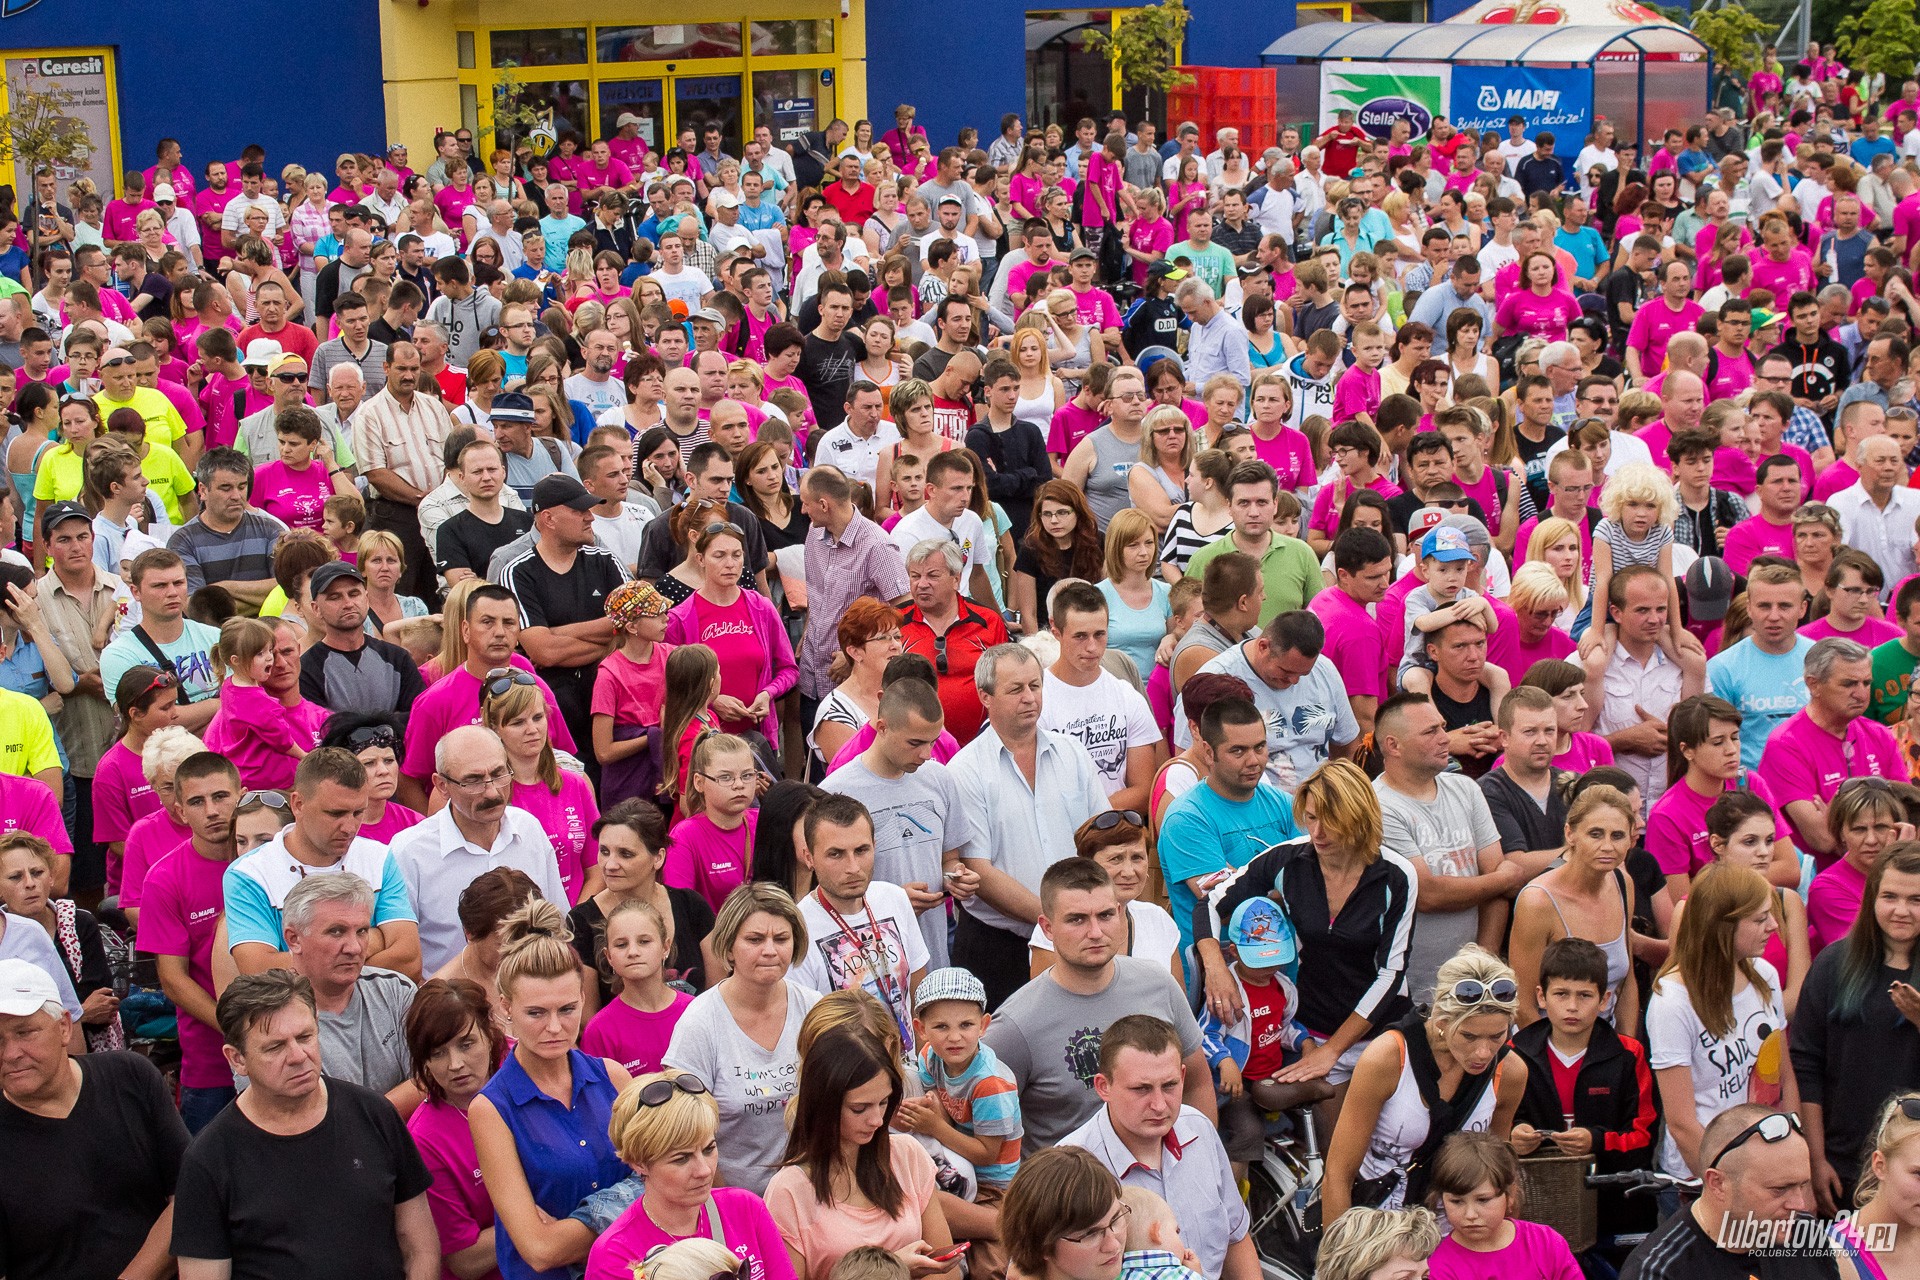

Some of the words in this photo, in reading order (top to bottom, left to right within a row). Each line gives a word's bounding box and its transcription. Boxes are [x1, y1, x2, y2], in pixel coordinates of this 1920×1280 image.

[41, 57, 102, 75] Ceresit
[1503, 88, 1561, 110] MAPEI
[1361, 111, 1395, 126] Stella
[1456, 116, 1507, 134] Budujesz
[1542, 106, 1585, 125] dobrze!
[1740, 695, 1798, 712] House
[734, 1066, 741, 1077] I
[779, 1062, 799, 1077] car
[744, 1102, 764, 1116] my
